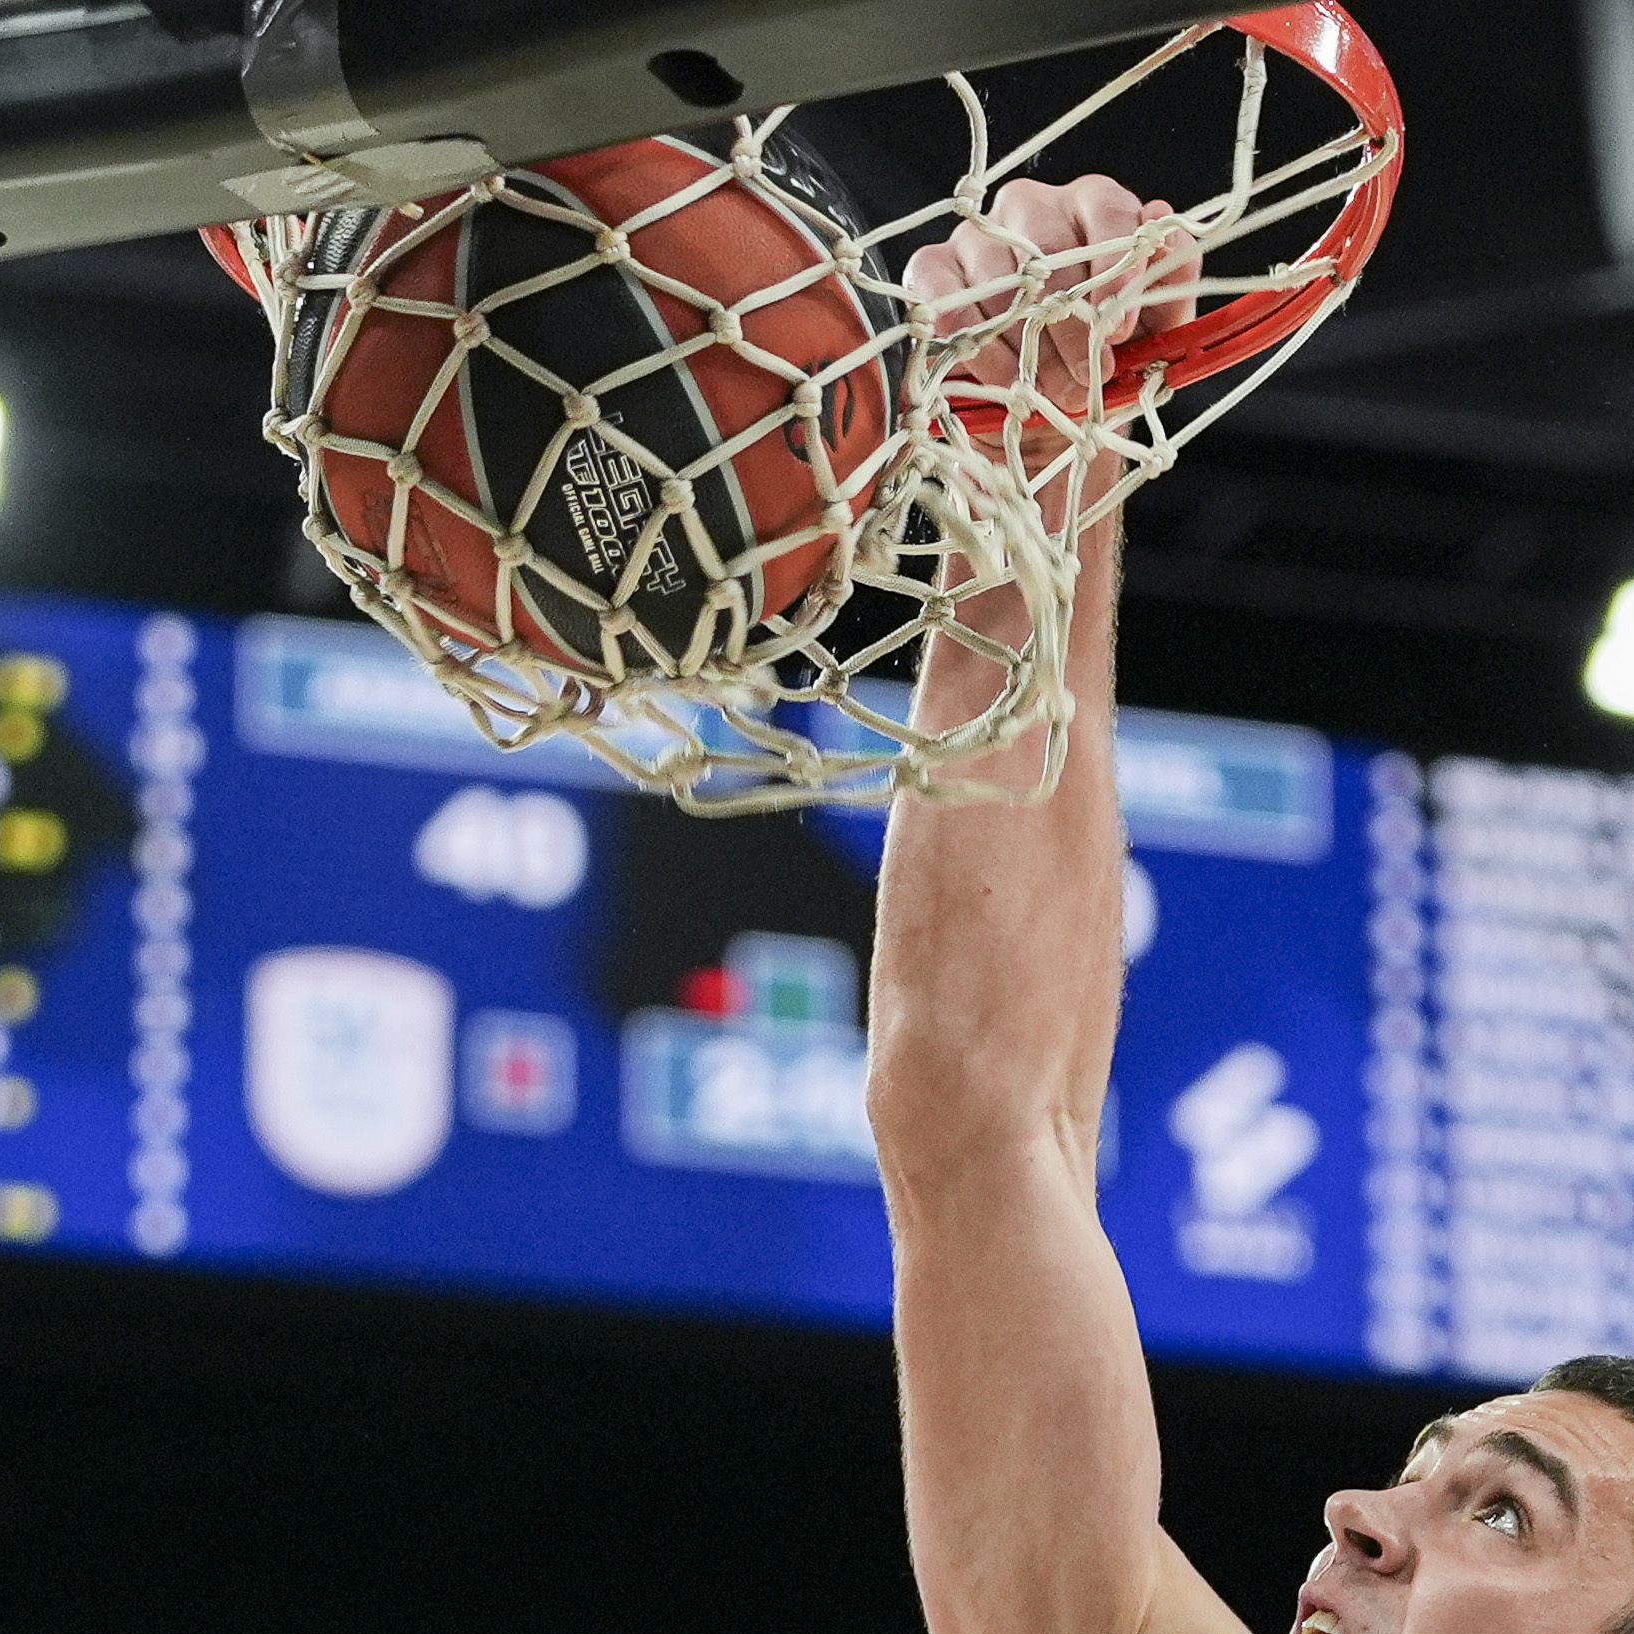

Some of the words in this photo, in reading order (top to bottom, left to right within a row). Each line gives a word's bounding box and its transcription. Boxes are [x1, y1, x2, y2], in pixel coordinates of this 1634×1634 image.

[562, 483, 586, 527] OFFICIAL
[578, 527, 596, 553] GAME
[588, 552, 605, 575] BALL
